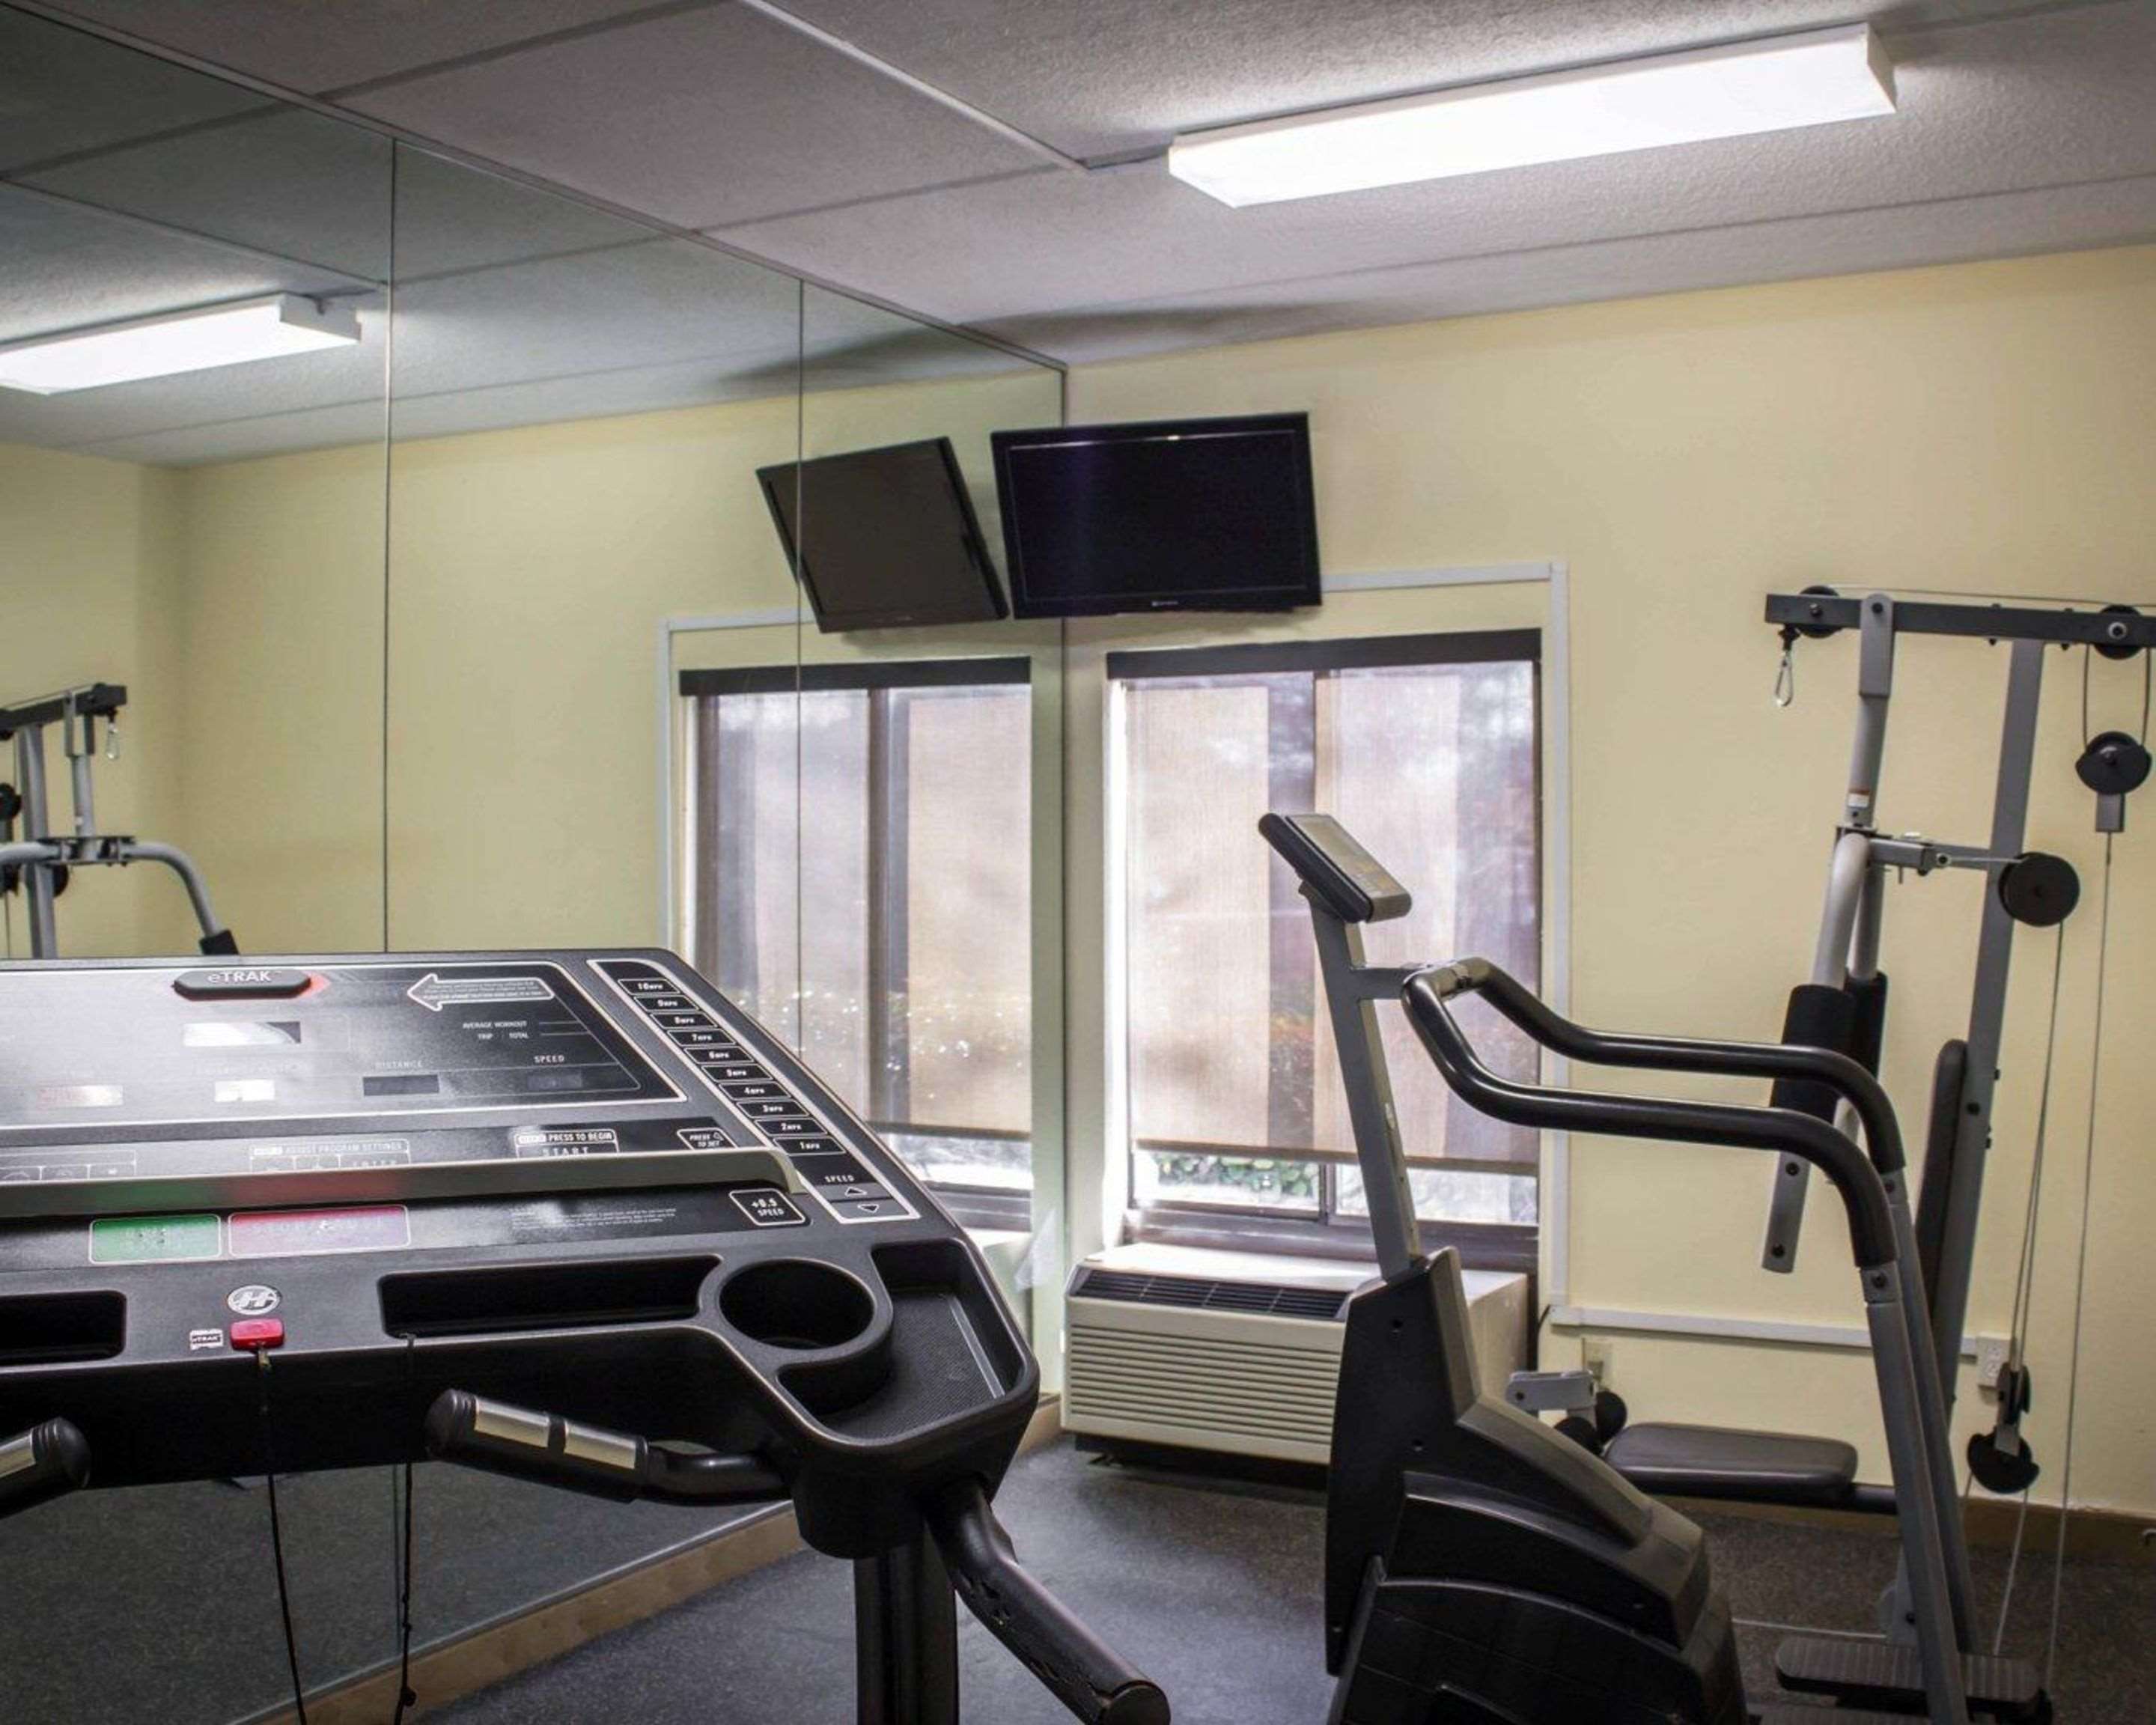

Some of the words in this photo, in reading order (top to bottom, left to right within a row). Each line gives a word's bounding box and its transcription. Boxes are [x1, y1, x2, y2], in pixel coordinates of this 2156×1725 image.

[207, 971, 272, 984] eTRAK
[534, 1055, 565, 1063] SPEED
[549, 1134, 575, 1143] PRESS
[575, 1133, 587, 1141] TO
[757, 1208, 785, 1217] SPEED
